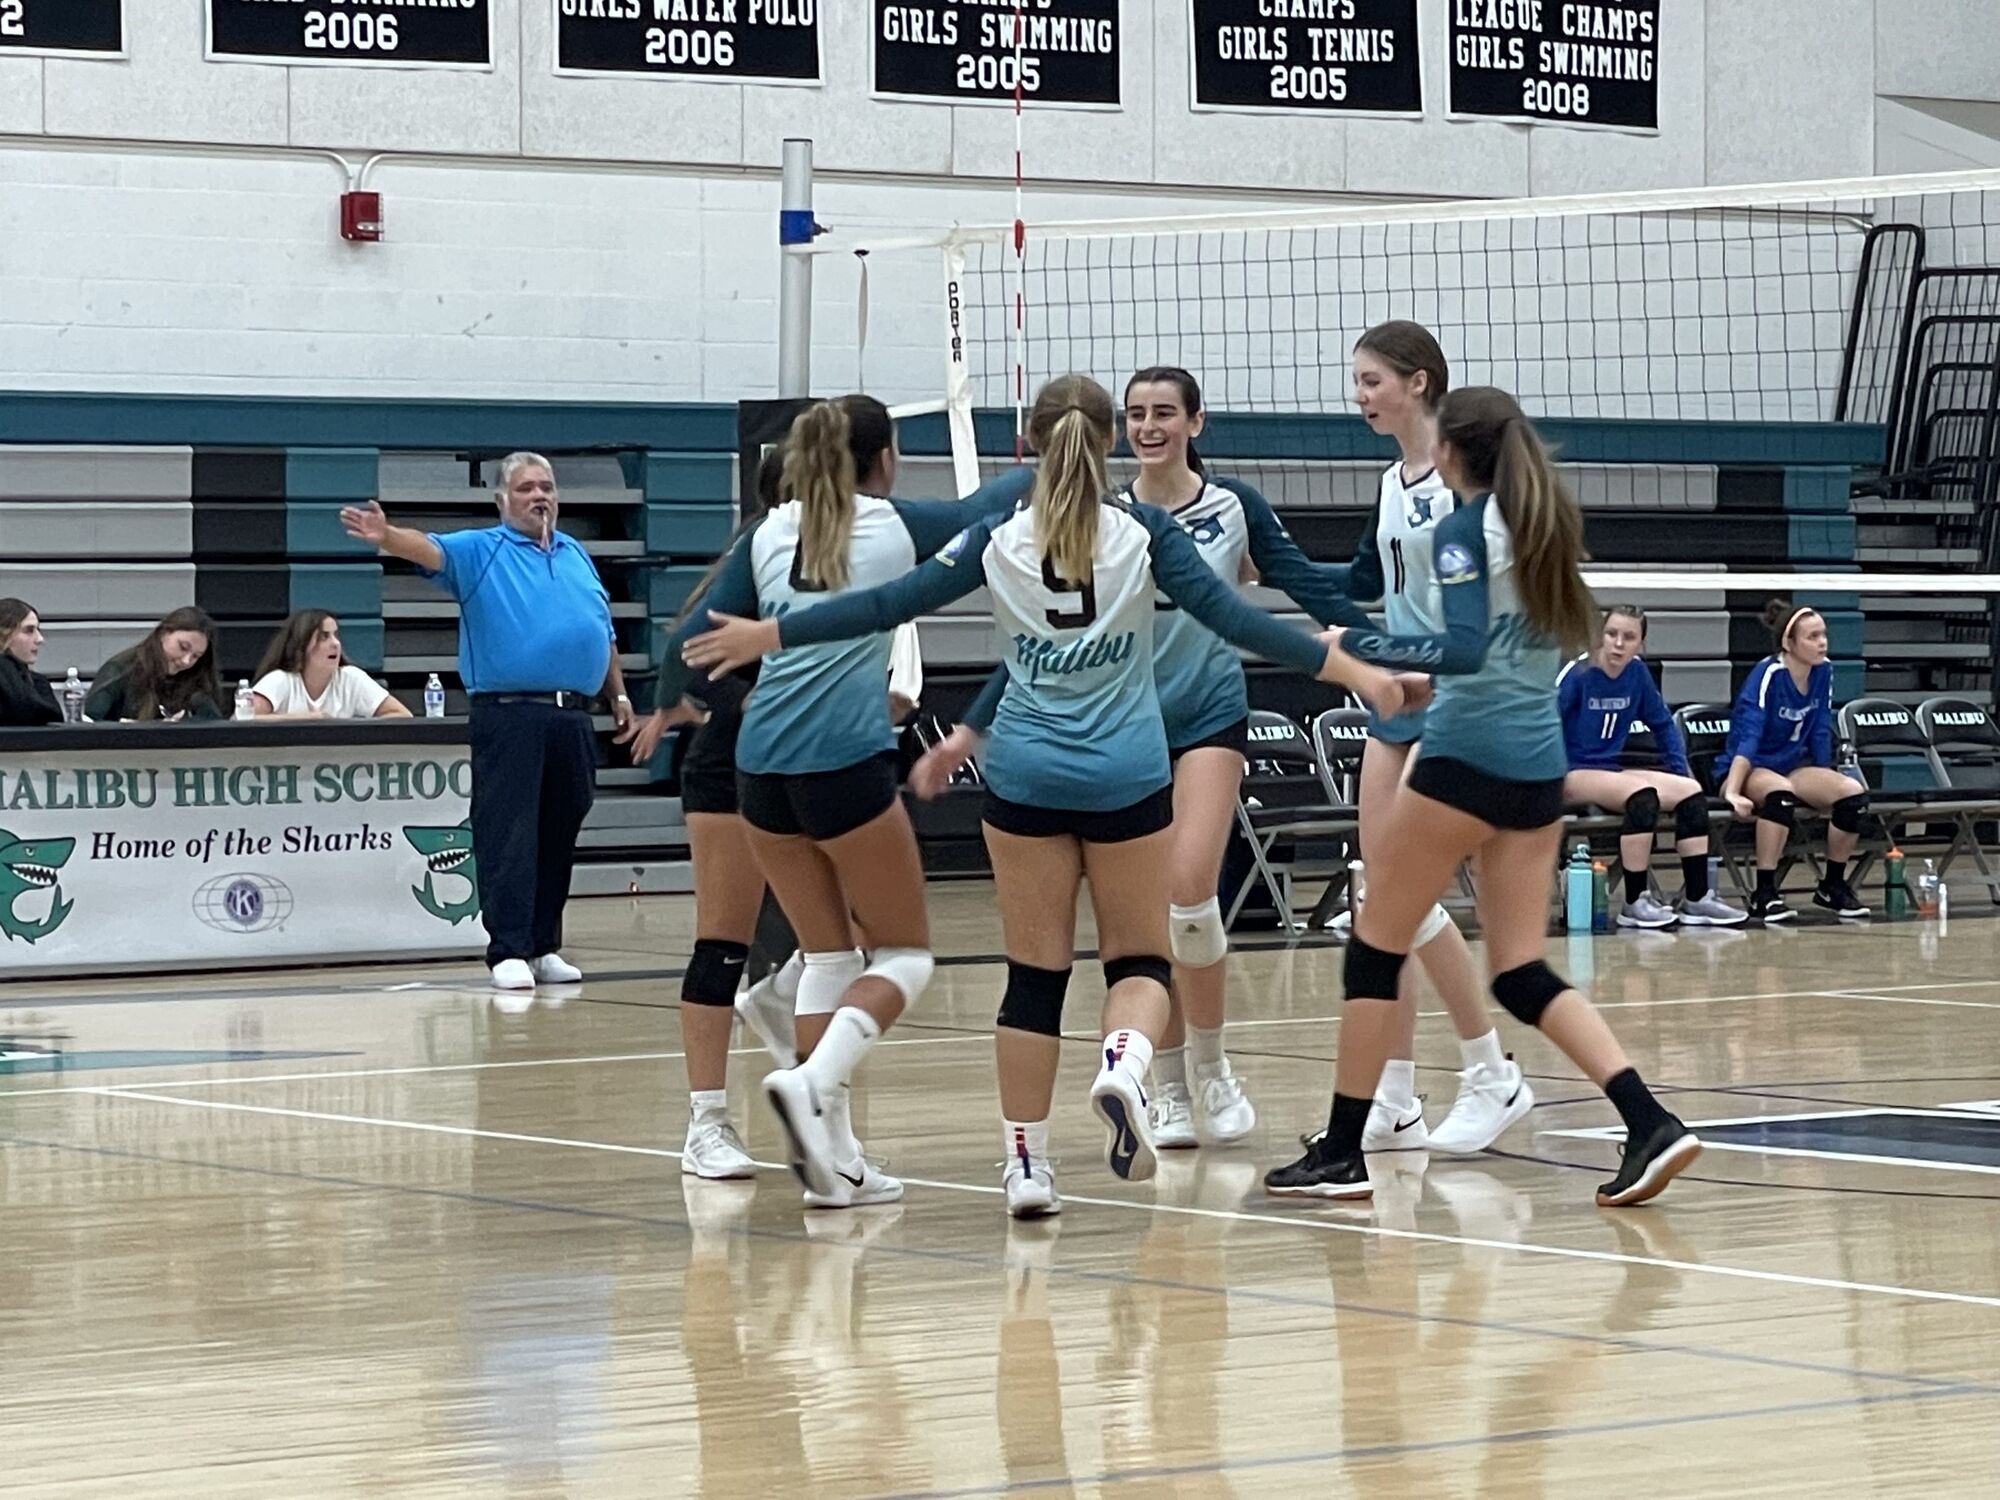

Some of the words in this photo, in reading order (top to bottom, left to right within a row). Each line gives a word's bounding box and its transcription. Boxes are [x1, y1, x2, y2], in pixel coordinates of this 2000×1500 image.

[653, 0, 737, 24] WATER
[748, 0, 814, 26] POLO
[1259, 0, 1355, 20] CHAMPS
[1456, 0, 1543, 33] LEAGUE
[1562, 4, 1653, 43] CHAMPS
[304, 11, 398, 50] 2006
[645, 28, 734, 66] 2006
[883, 6, 958, 45] GIRLS
[980, 13, 1112, 53] SWIMMING
[1218, 26, 1288, 60] GIRLS
[1307, 28, 1394, 62] TENNIS
[956, 54, 1040, 91] 2005
[1456, 34, 1525, 70] GIRLS
[1539, 41, 1653, 82] SWIMMING
[1270, 65, 1347, 101] 2005
[1522, 78, 1589, 116] 2008
[1013, 631, 1135, 690] Malibu
[1247, 725, 1295, 741] ALIBU
[1329, 726, 1369, 740] MALI
[1600, 712, 1618, 739] 11
[1685, 720, 1730, 734] MALIB
[1853, 711, 1909, 726] MALIBU
[1932, 711, 1985, 725] MALIBU
[0, 769, 159, 810] ALIBU
[171, 765, 302, 806] HIGH
[313, 759, 472, 803] SCHOO
[90, 831, 176, 860] Home
[185, 828, 219, 864] of
[224, 828, 272, 856] the
[282, 823, 393, 854] Sharks
